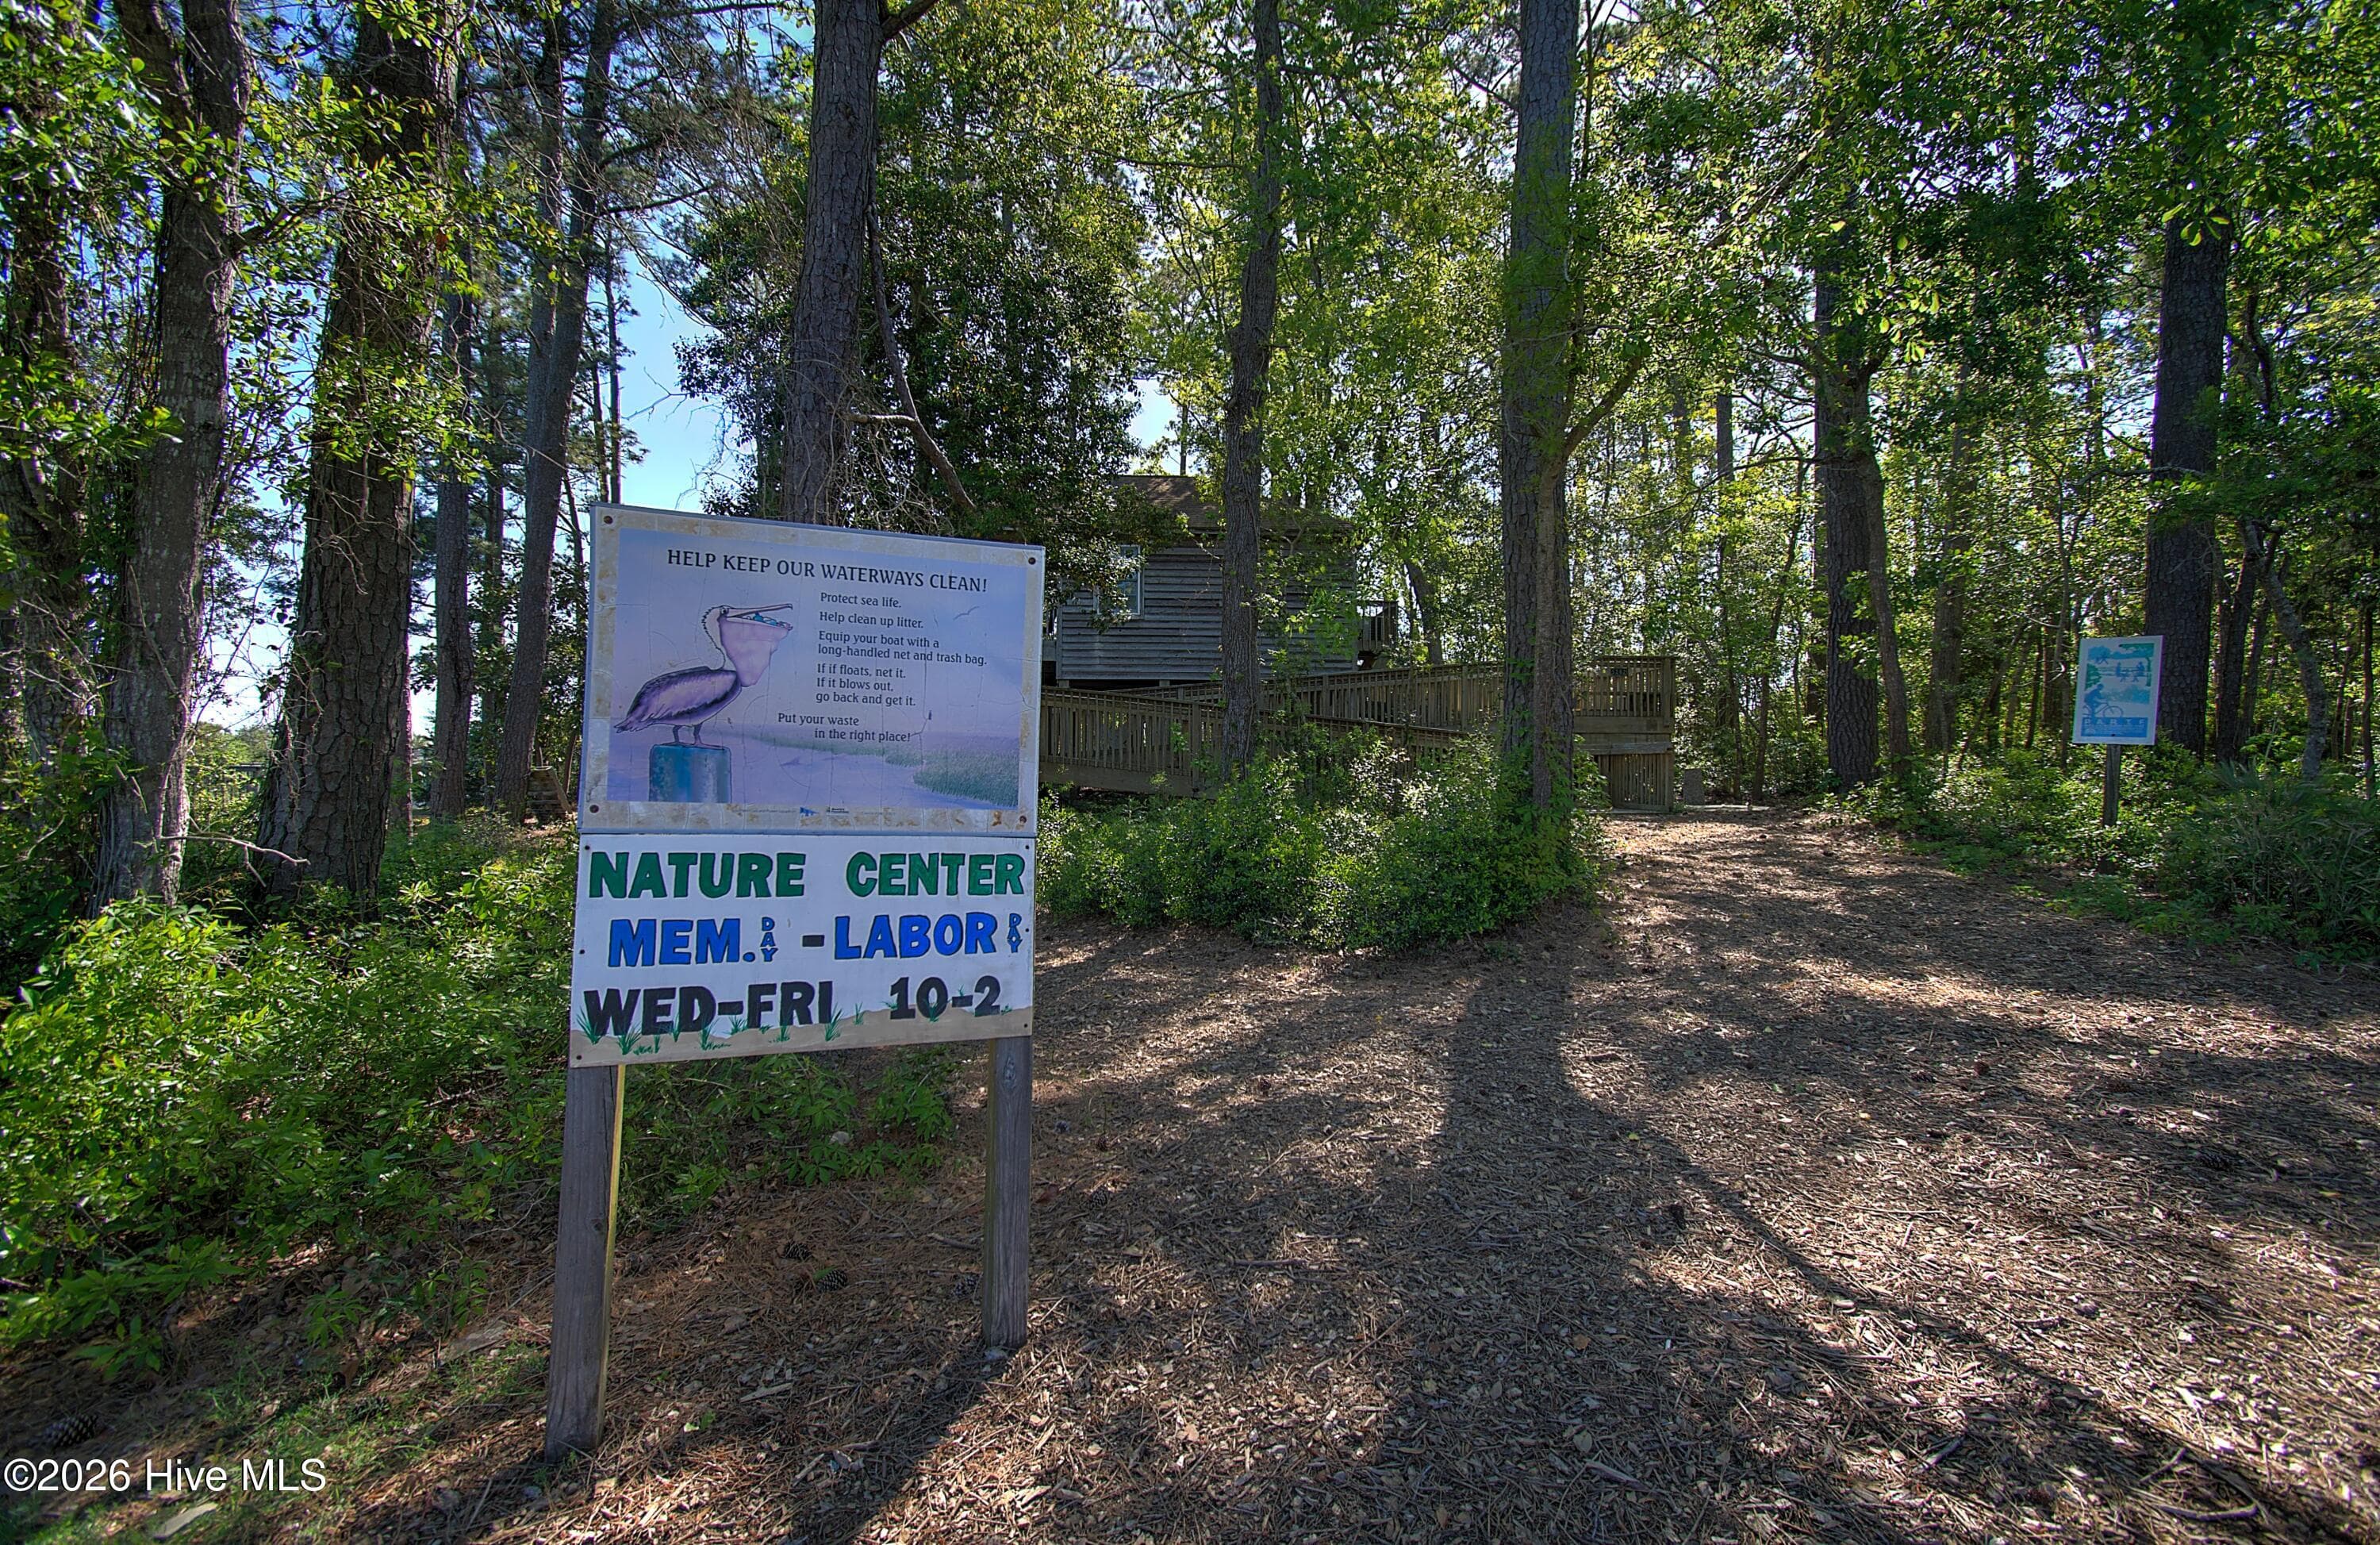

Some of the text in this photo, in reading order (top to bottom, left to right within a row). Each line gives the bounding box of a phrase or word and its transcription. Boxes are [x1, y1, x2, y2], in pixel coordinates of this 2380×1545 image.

[667, 549, 987, 592] HELP KEEP OUR WATERWAYS CLEAN!
[820, 592, 902, 608] Protect sea life.
[820, 612, 923, 628] Help clean up litter.
[819, 631, 850, 643] Equip
[853, 634, 877, 645] your
[881, 634, 904, 646] boat
[907, 637, 930, 648] with
[818, 644, 987, 667] long-handled net and trash bag.
[817, 663, 825, 674] If
[876, 668, 892, 678] net
[896, 668, 906, 678] it.
[817, 678, 825, 687] If
[828, 678, 835, 688] it
[839, 678, 870, 690] blows
[816, 692, 916, 707] go back and get it.
[777, 713, 859, 726] Put your waste
[815, 728, 911, 743] in the right place!
[589, 851, 1025, 899] NATURE CENTER
[608, 918, 757, 967] MEM.
[759, 916, 778, 963] DAY
[1007, 913, 1023, 954] DAY
[584, 975, 1001, 1036] WED-FRI 10-2
